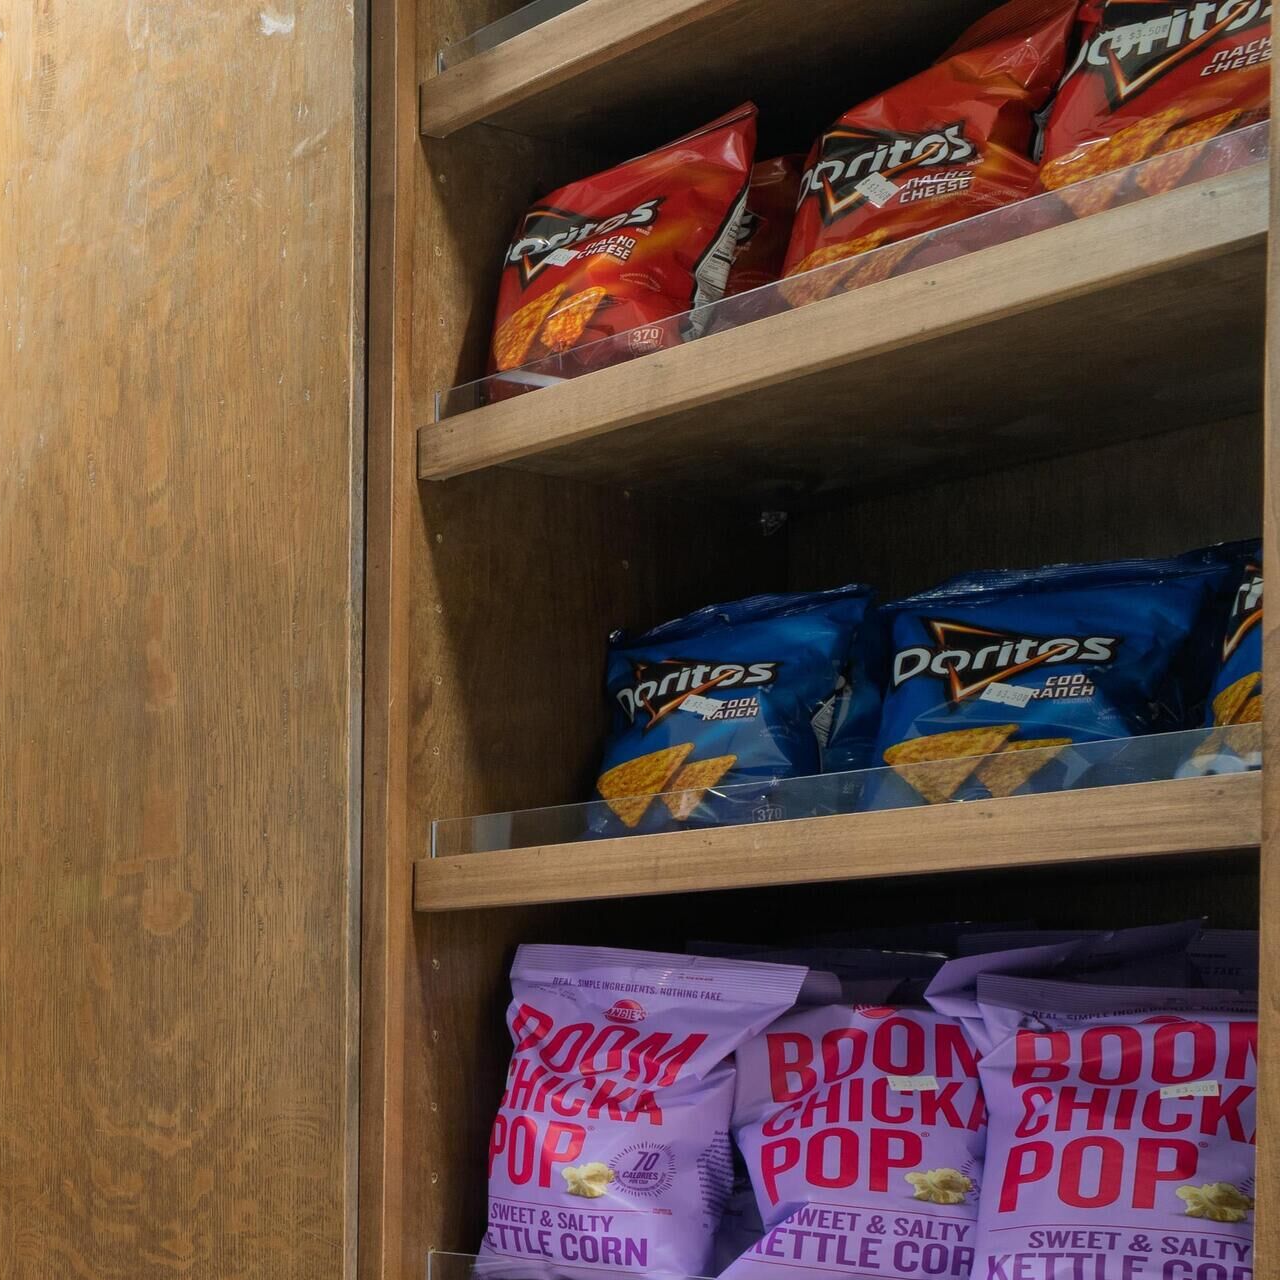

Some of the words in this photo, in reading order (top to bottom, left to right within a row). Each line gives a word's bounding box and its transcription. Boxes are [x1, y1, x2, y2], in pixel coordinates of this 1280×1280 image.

[900, 178, 971, 203] CHEESE
[905, 169, 972, 188] NACHO
[577, 245, 632, 261] CHEESE
[586, 235, 636, 250] NACHO
[892, 636, 1118, 687] Doritos
[1031, 683, 1095, 699] RANCH
[577, 979, 601, 989] SIMPLE
[660, 988, 698, 999] NOTHING
[511, 1003, 709, 1086] BOOM
[489, 1115, 588, 1188] POP
[632, 1151, 660, 1171] 70
[759, 1128, 923, 1205] POP
[998, 1137, 1198, 1212] POP
[490, 1202, 536, 1225] SWEET
[541, 1211, 553, 1227] &
[557, 1212, 614, 1233] SALTY
[785, 1209, 861, 1233] SWEET
[866, 1214, 887, 1234] &
[891, 1215, 971, 1243] SALTY
[560, 1232, 648, 1267] CORN
[1028, 1229, 1123, 1251] SWEET
[1130, 1232, 1152, 1255] &
[1154, 1233, 1251, 1261] SALTY
